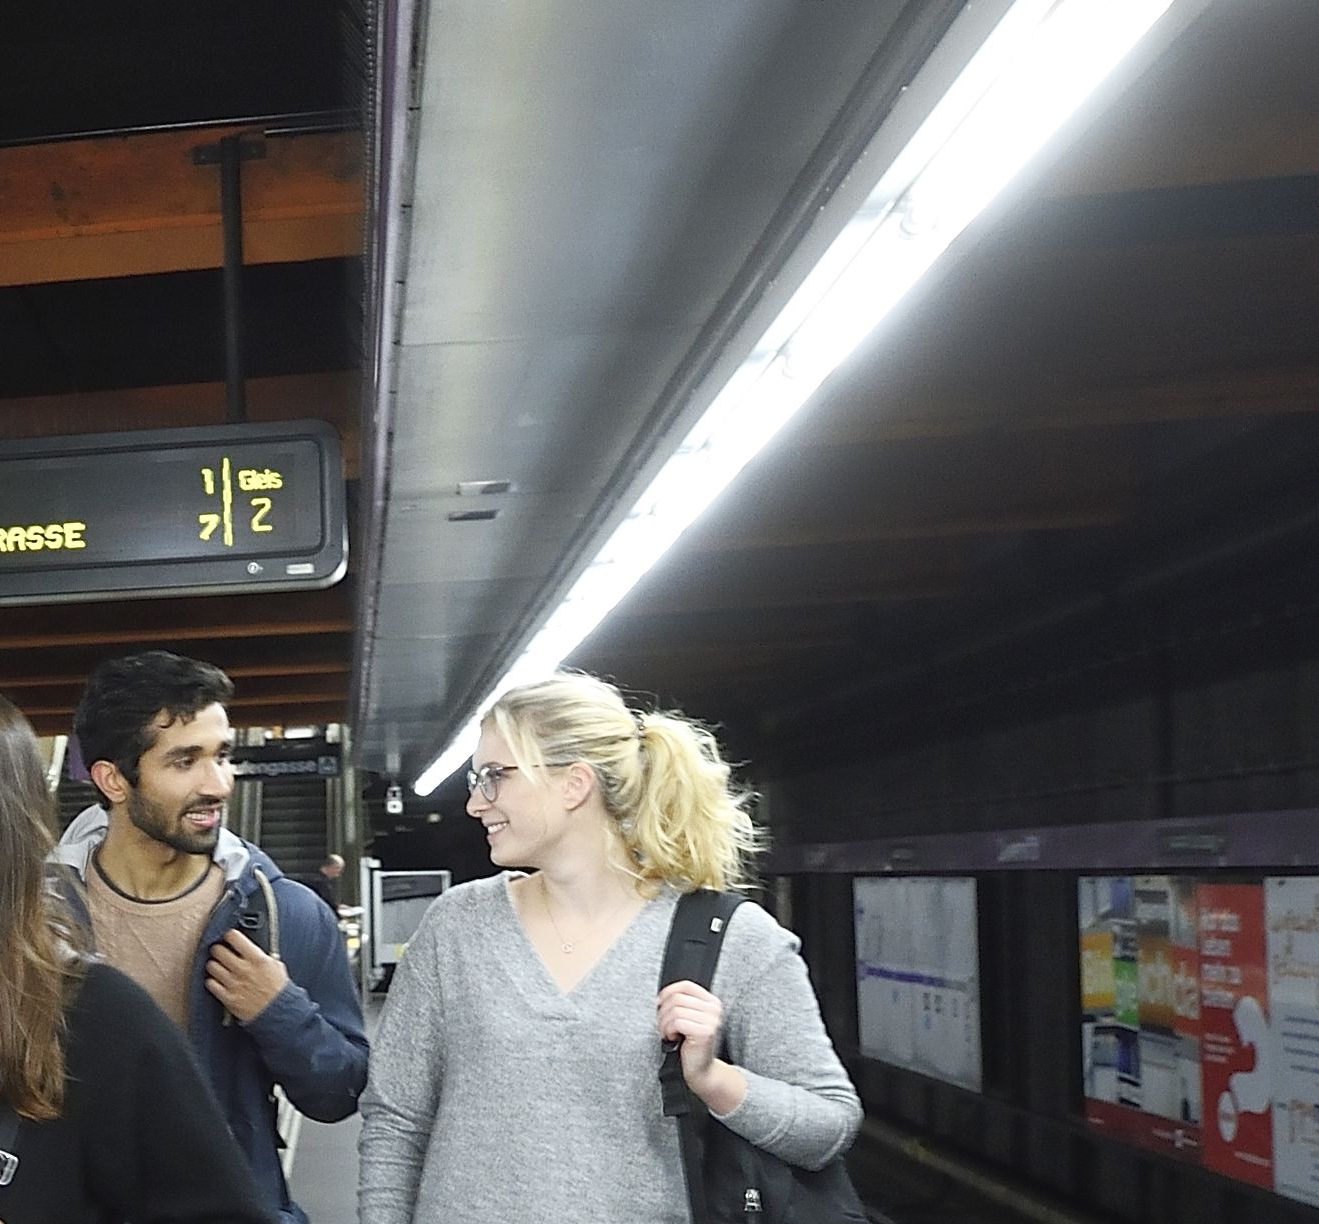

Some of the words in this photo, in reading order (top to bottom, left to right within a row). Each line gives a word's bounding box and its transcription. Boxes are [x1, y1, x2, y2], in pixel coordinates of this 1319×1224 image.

[201, 468, 215, 495] 1
[198, 513, 222, 541] 7
[250, 497, 273, 533] 2
